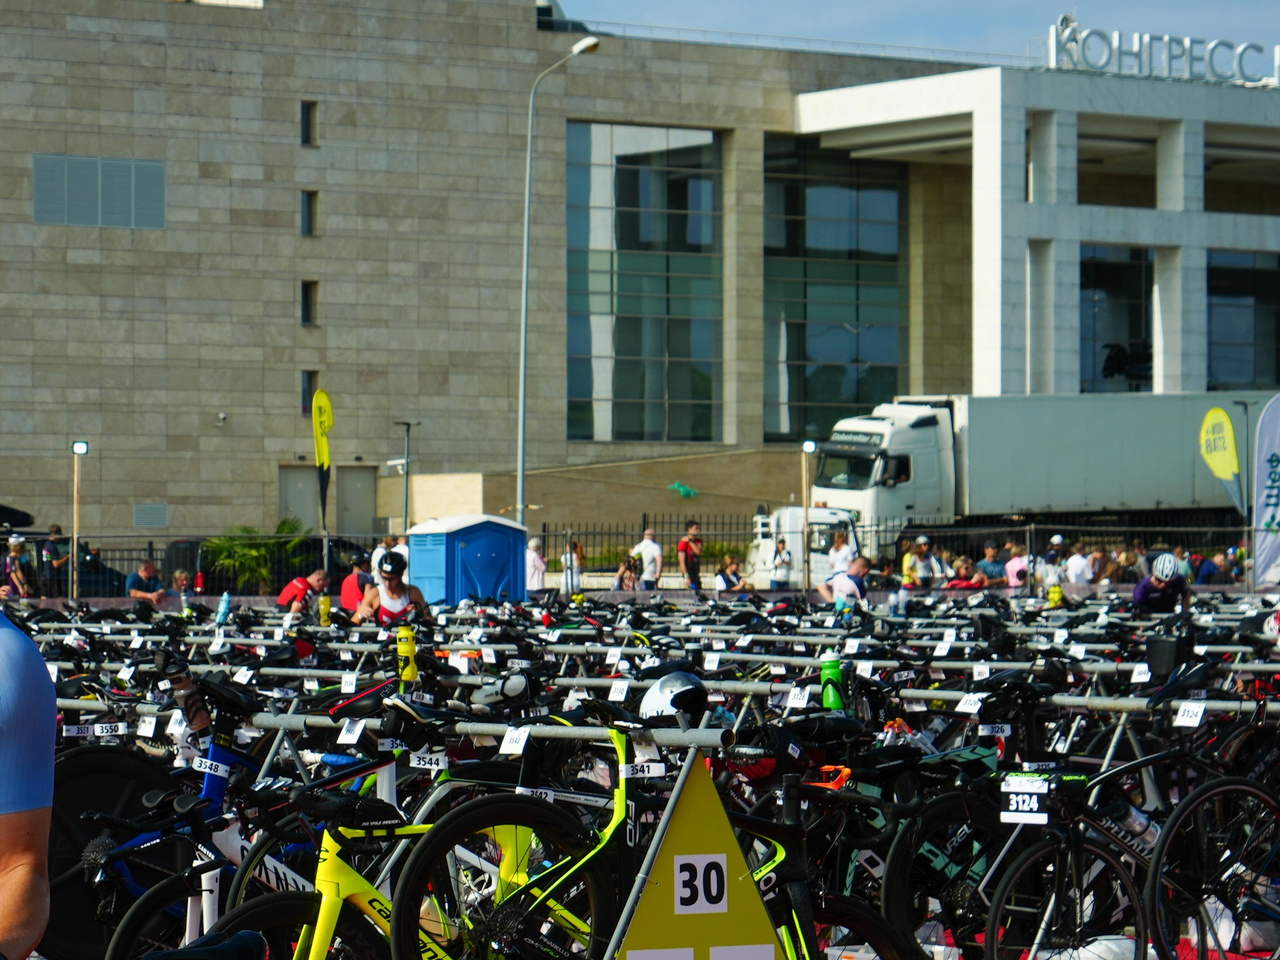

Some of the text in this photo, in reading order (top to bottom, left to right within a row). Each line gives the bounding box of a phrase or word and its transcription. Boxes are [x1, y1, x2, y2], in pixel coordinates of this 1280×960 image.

[1049, 24, 1264, 83] КОНГРЕСС
[1181, 708, 1199, 719] 3124
[99, 725, 119, 734] 3550
[990, 725, 1006, 734] 3126
[196, 759, 220, 773] 3548
[416, 756, 440, 767] 3544
[630, 764, 651, 775] 3541
[1008, 793, 1039, 812] 3124
[679, 861, 725, 906] 30
[539, 935, 570, 958] PINARELLO
